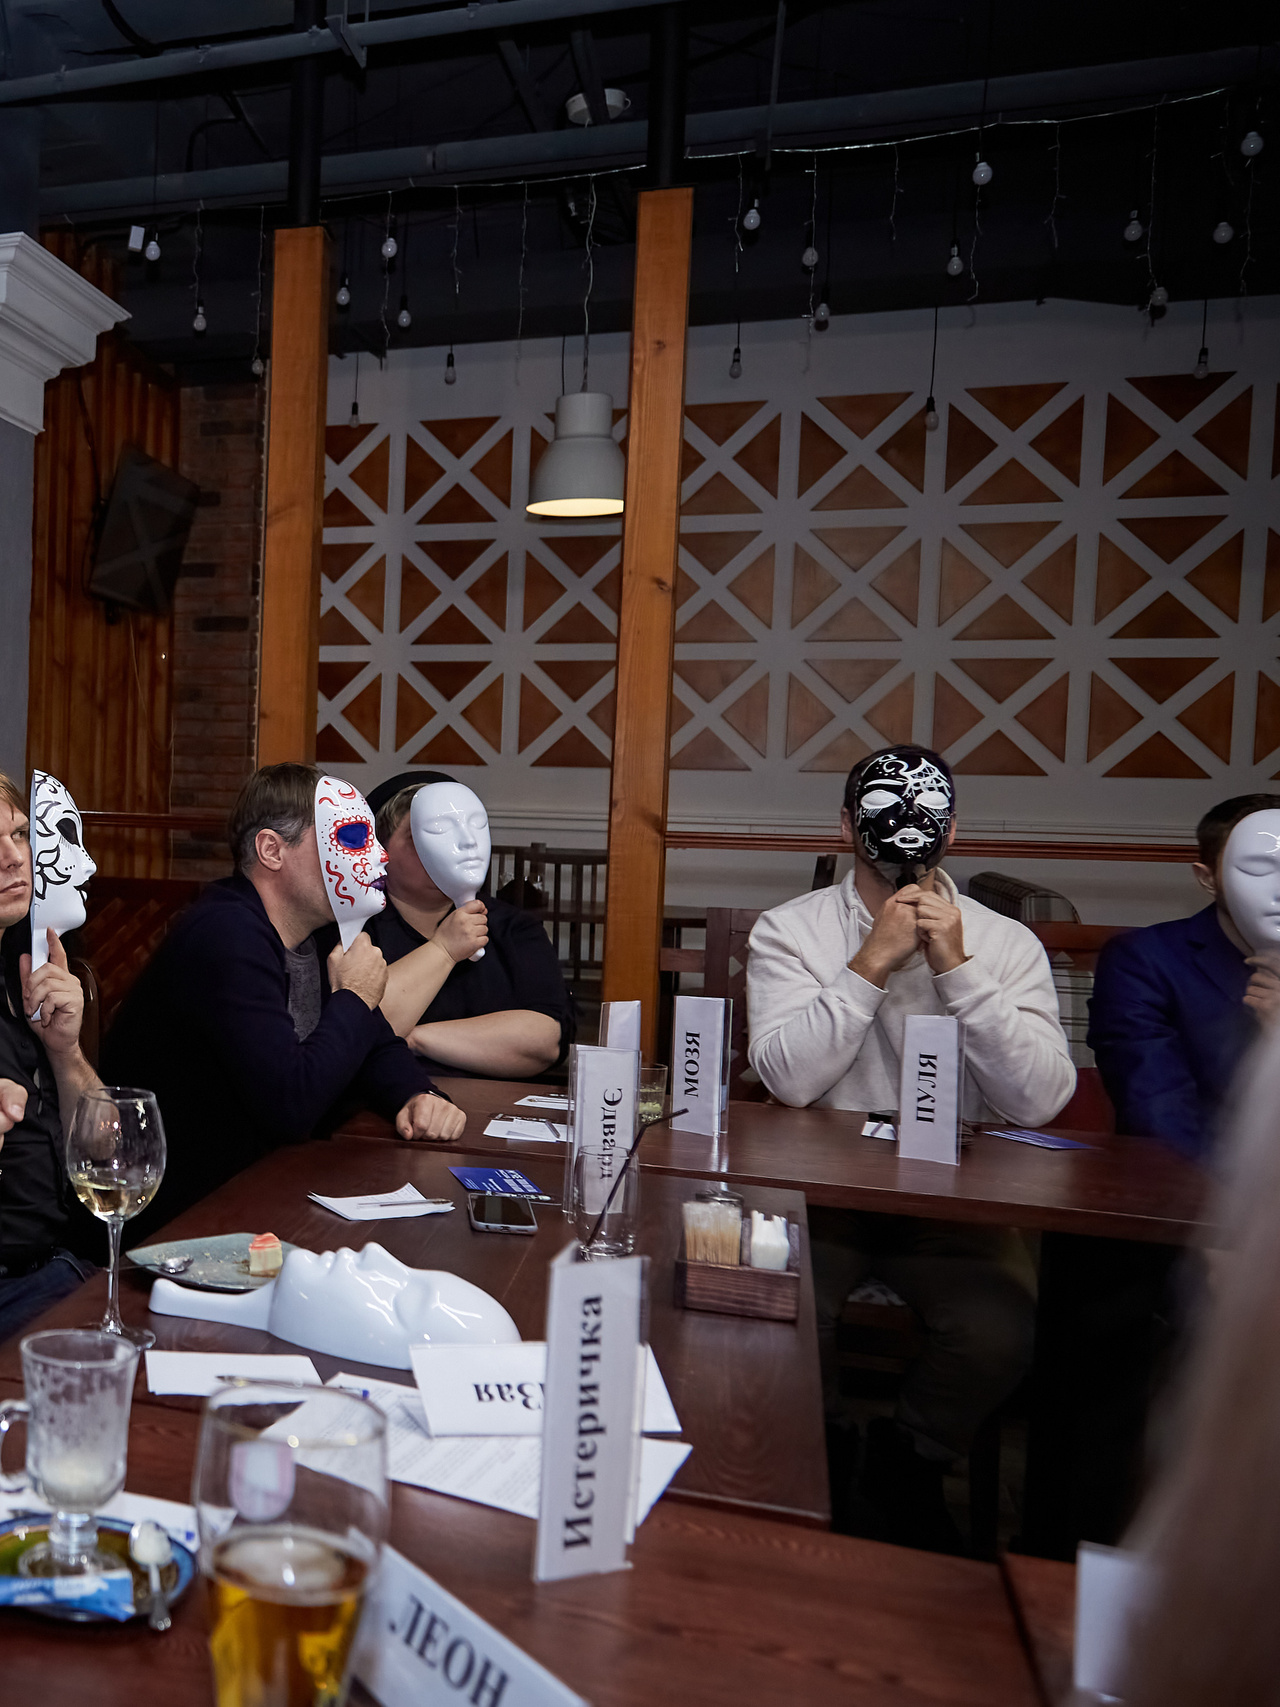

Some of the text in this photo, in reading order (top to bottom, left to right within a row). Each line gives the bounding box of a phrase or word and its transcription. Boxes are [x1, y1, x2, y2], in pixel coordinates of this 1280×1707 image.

[684, 1031, 701, 1098] МОЗЯ
[916, 1052, 938, 1124] ПУЛЯ
[600, 1088, 624, 1180] Эдвард
[473, 1383, 545, 1411] Зая
[563, 1294, 606, 1552] Истеричка
[389, 1594, 510, 1707] ЛЕОН
